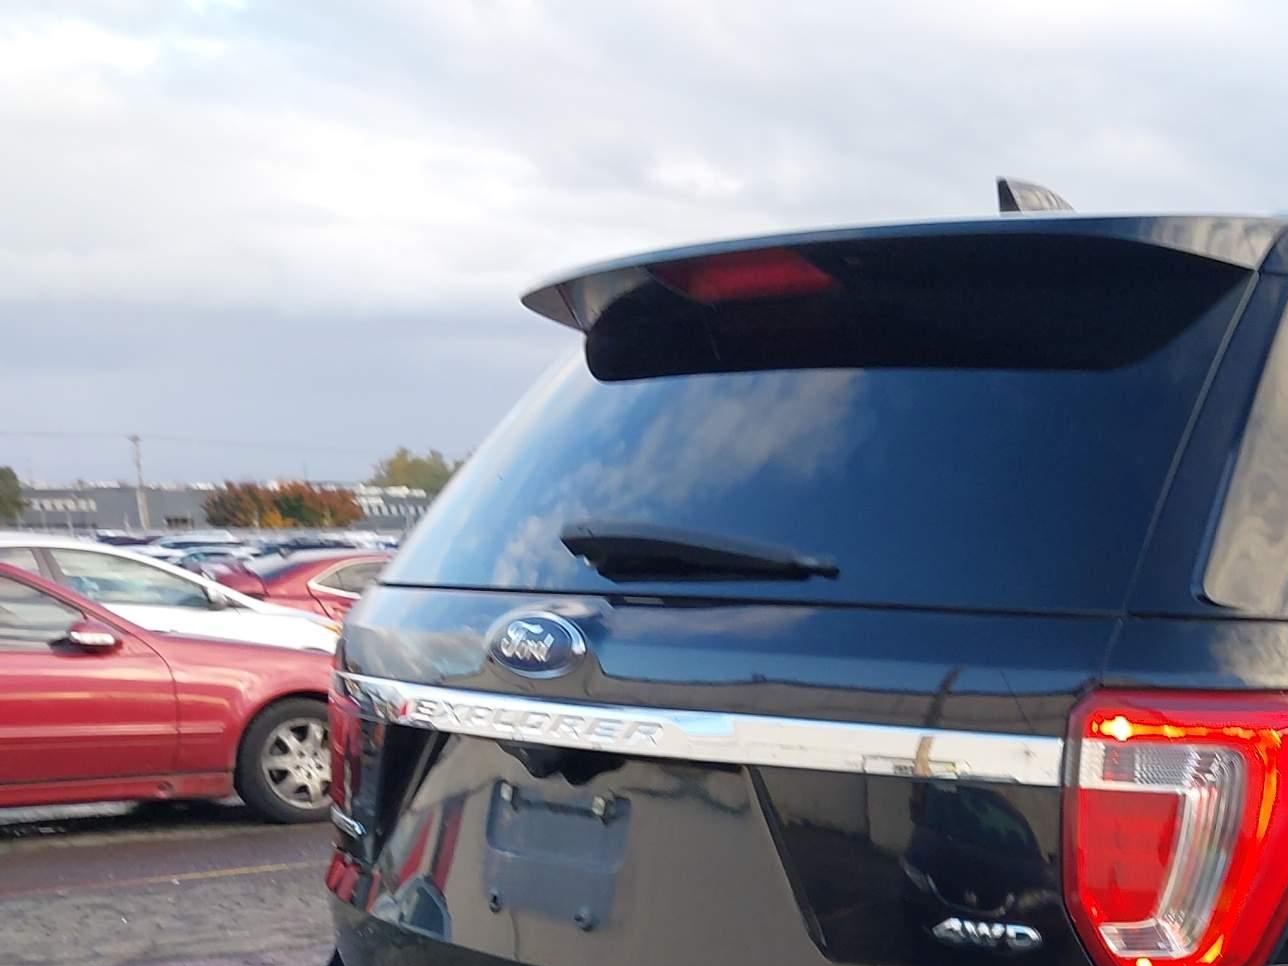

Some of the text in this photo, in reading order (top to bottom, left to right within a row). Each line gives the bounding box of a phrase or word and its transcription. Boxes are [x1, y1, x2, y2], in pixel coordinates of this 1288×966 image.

[500, 620, 555, 662] Ford
[409, 699, 664, 745] EXPLORER
[932, 917, 1042, 948] AWD
